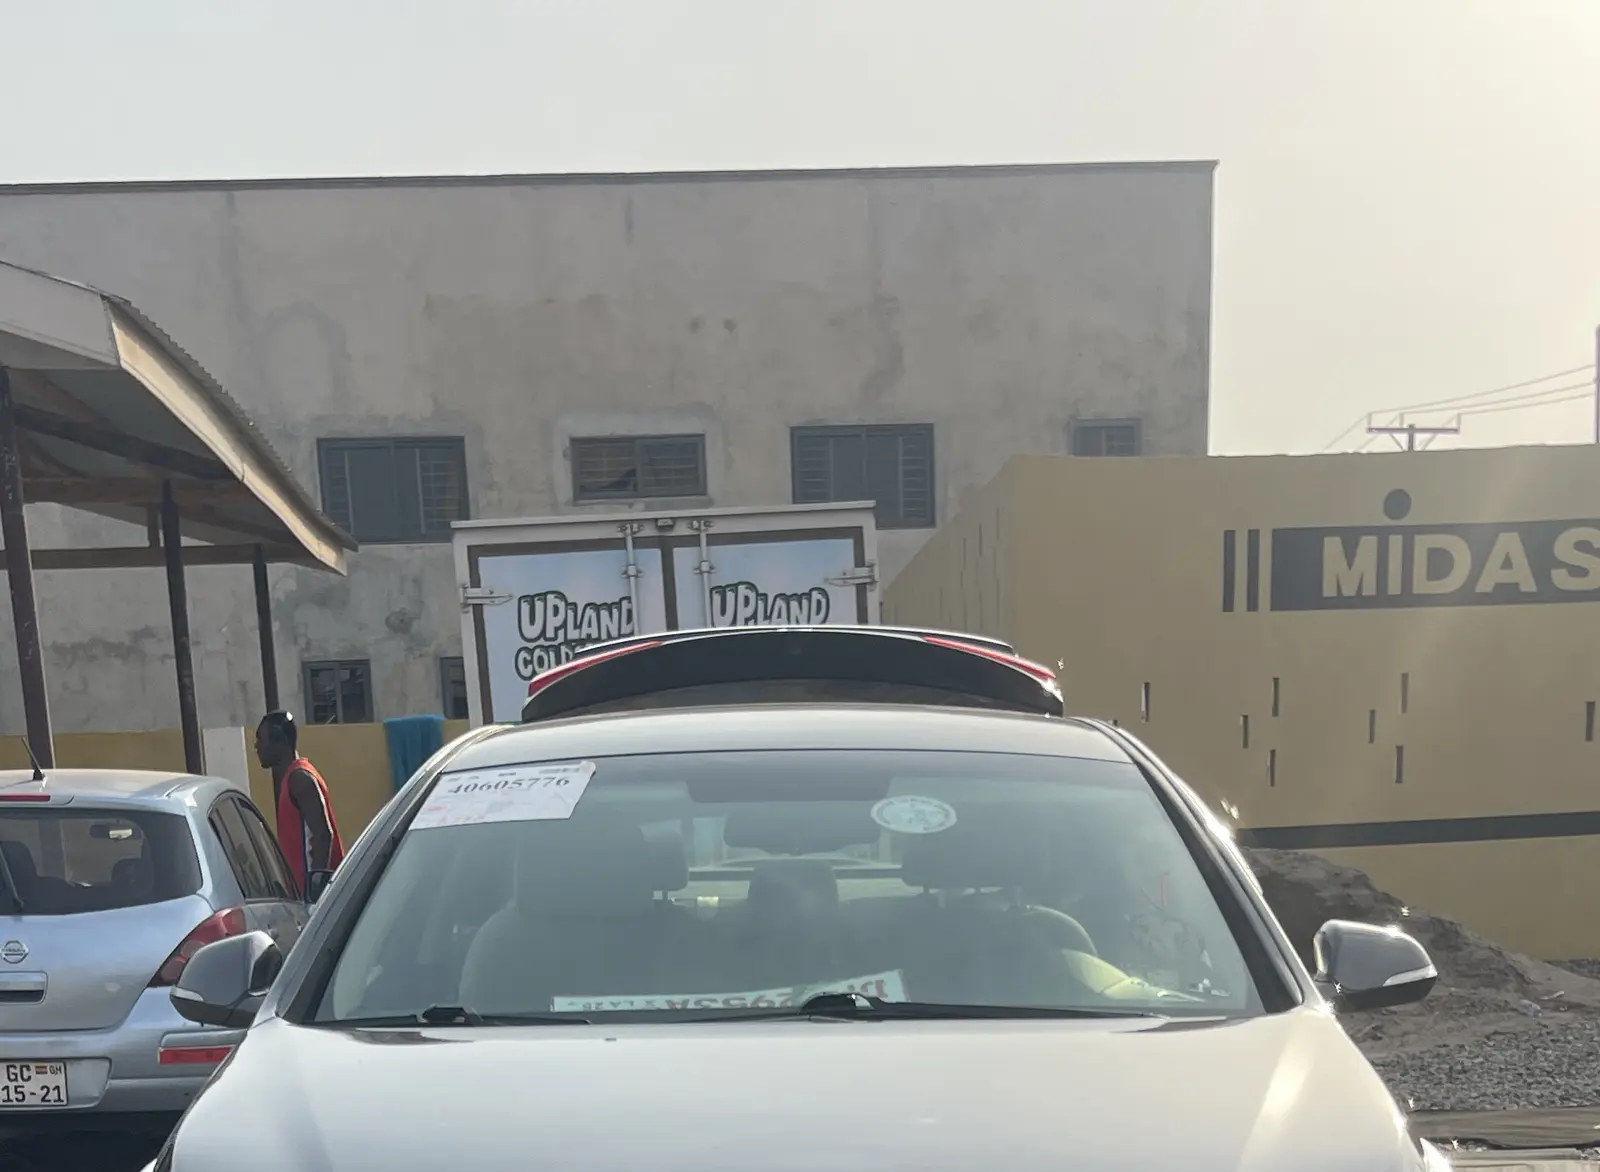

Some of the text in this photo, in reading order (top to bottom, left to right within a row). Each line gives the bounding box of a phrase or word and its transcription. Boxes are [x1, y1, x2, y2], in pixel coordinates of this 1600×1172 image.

[1321, 526, 1600, 598] MIDAS
[710, 581, 830, 628] UPLAND
[447, 777, 571, 795] 40605776
[6, 1064, 31, 1083] GC
